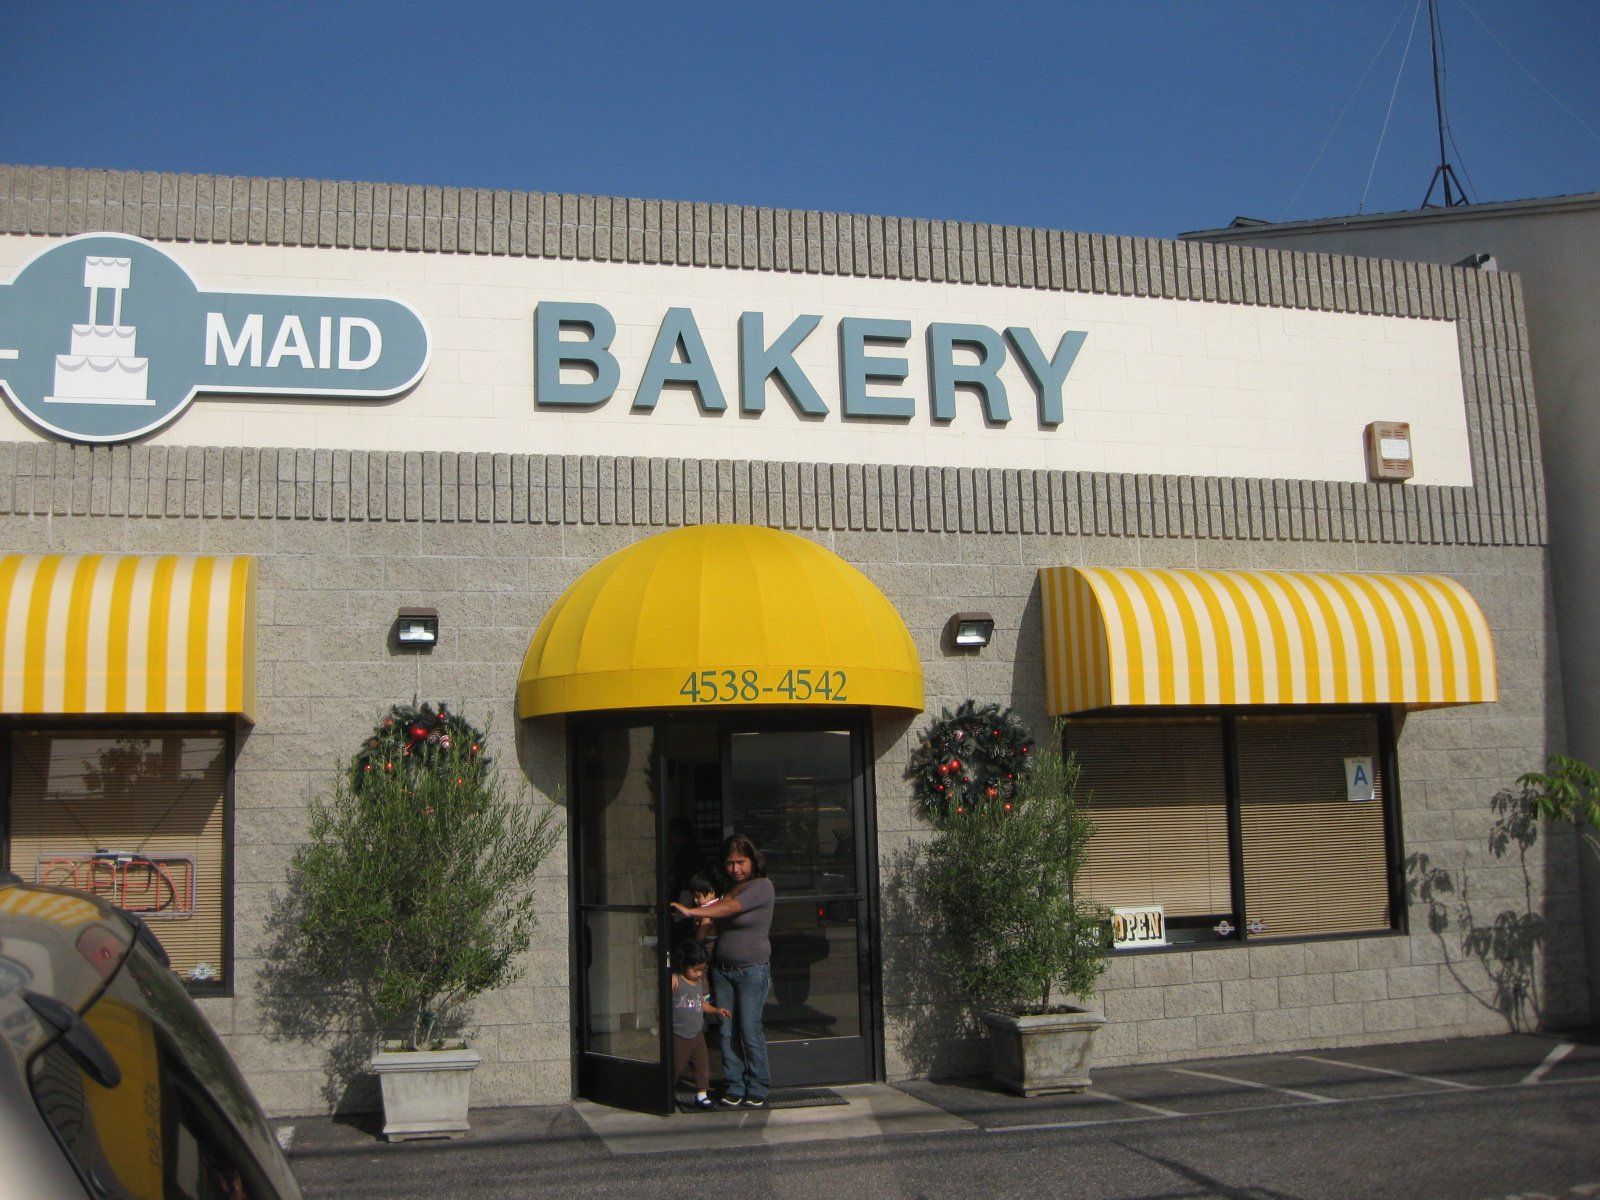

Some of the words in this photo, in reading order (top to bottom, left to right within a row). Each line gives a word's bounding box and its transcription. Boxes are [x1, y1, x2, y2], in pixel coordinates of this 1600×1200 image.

[205, 312, 382, 370] MAID
[534, 301, 1089, 426] BAKERY
[679, 669, 848, 703] 4538-4542
[1353, 764, 1369, 785] A
[1113, 911, 1163, 942] OPEN
